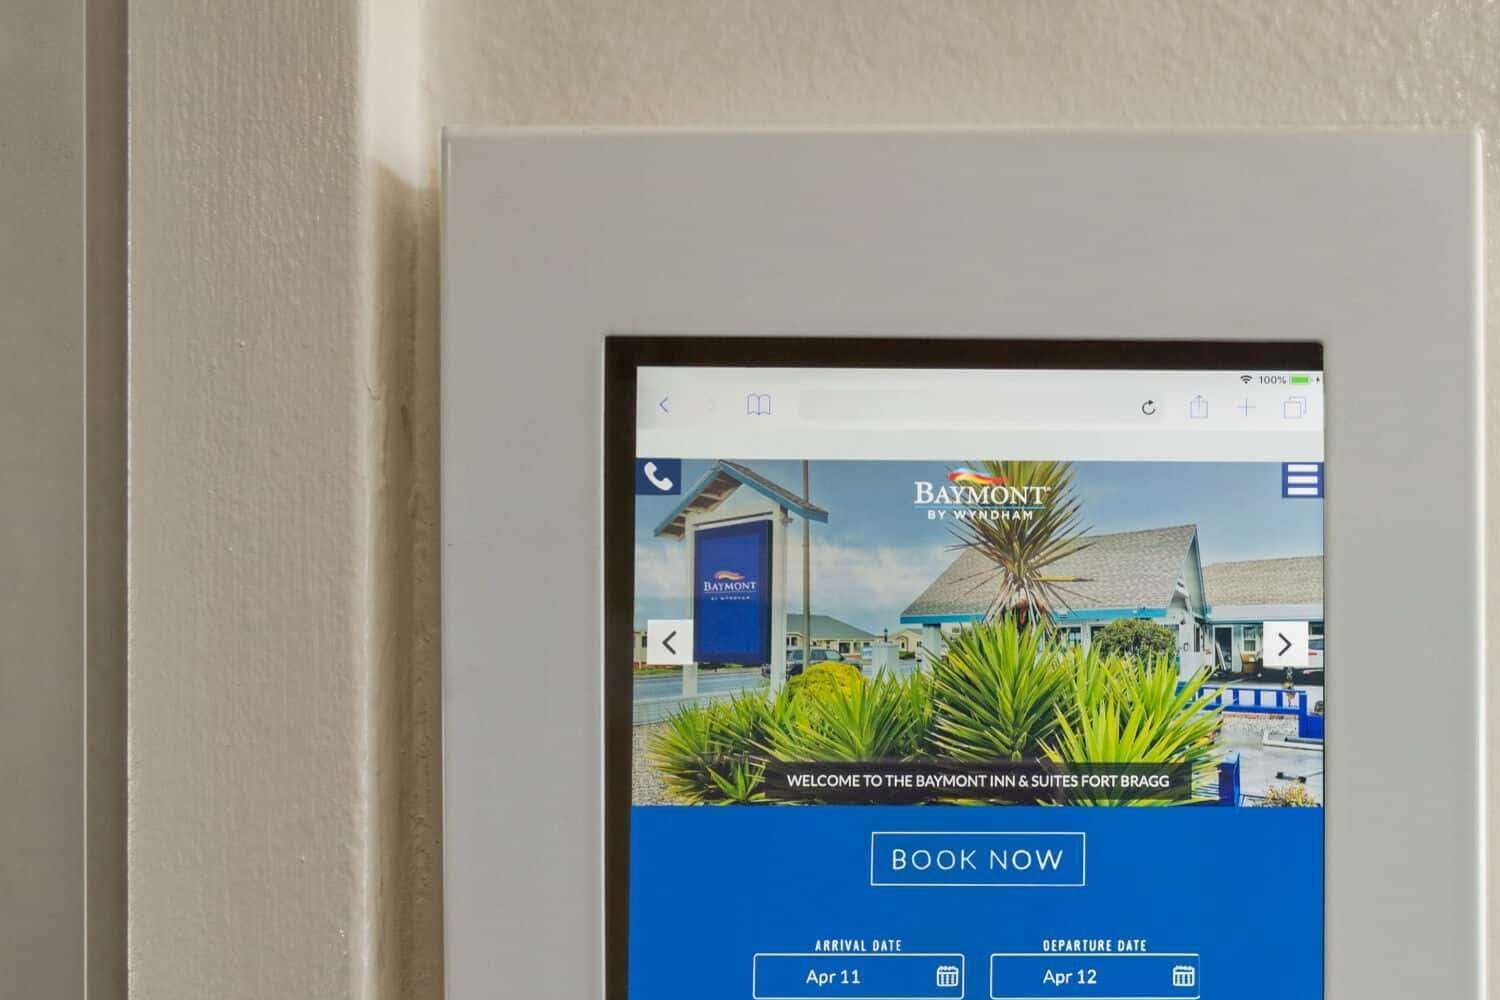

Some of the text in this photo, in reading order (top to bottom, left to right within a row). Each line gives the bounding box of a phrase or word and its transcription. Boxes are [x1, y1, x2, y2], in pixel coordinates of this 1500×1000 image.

[1259, 375, 1287, 385] 100%
[913, 480, 1044, 505] BAYMONT
[927, 509, 1033, 520] BY WYNDHAM
[703, 581, 757, 593] BAYMONT
[786, 774, 1170, 788] WELCOME TO THE BAYMONT INN & SUITES FORT BRAGG
[892, 848, 1064, 871] BOOK NOW
[815, 939, 902, 952] ARRIVAL DATE
[1043, 939, 1148, 952] DEPARTURE DATE
[806, 969, 861, 986] Apr 11
[1042, 969, 1097, 986] Apr 12
